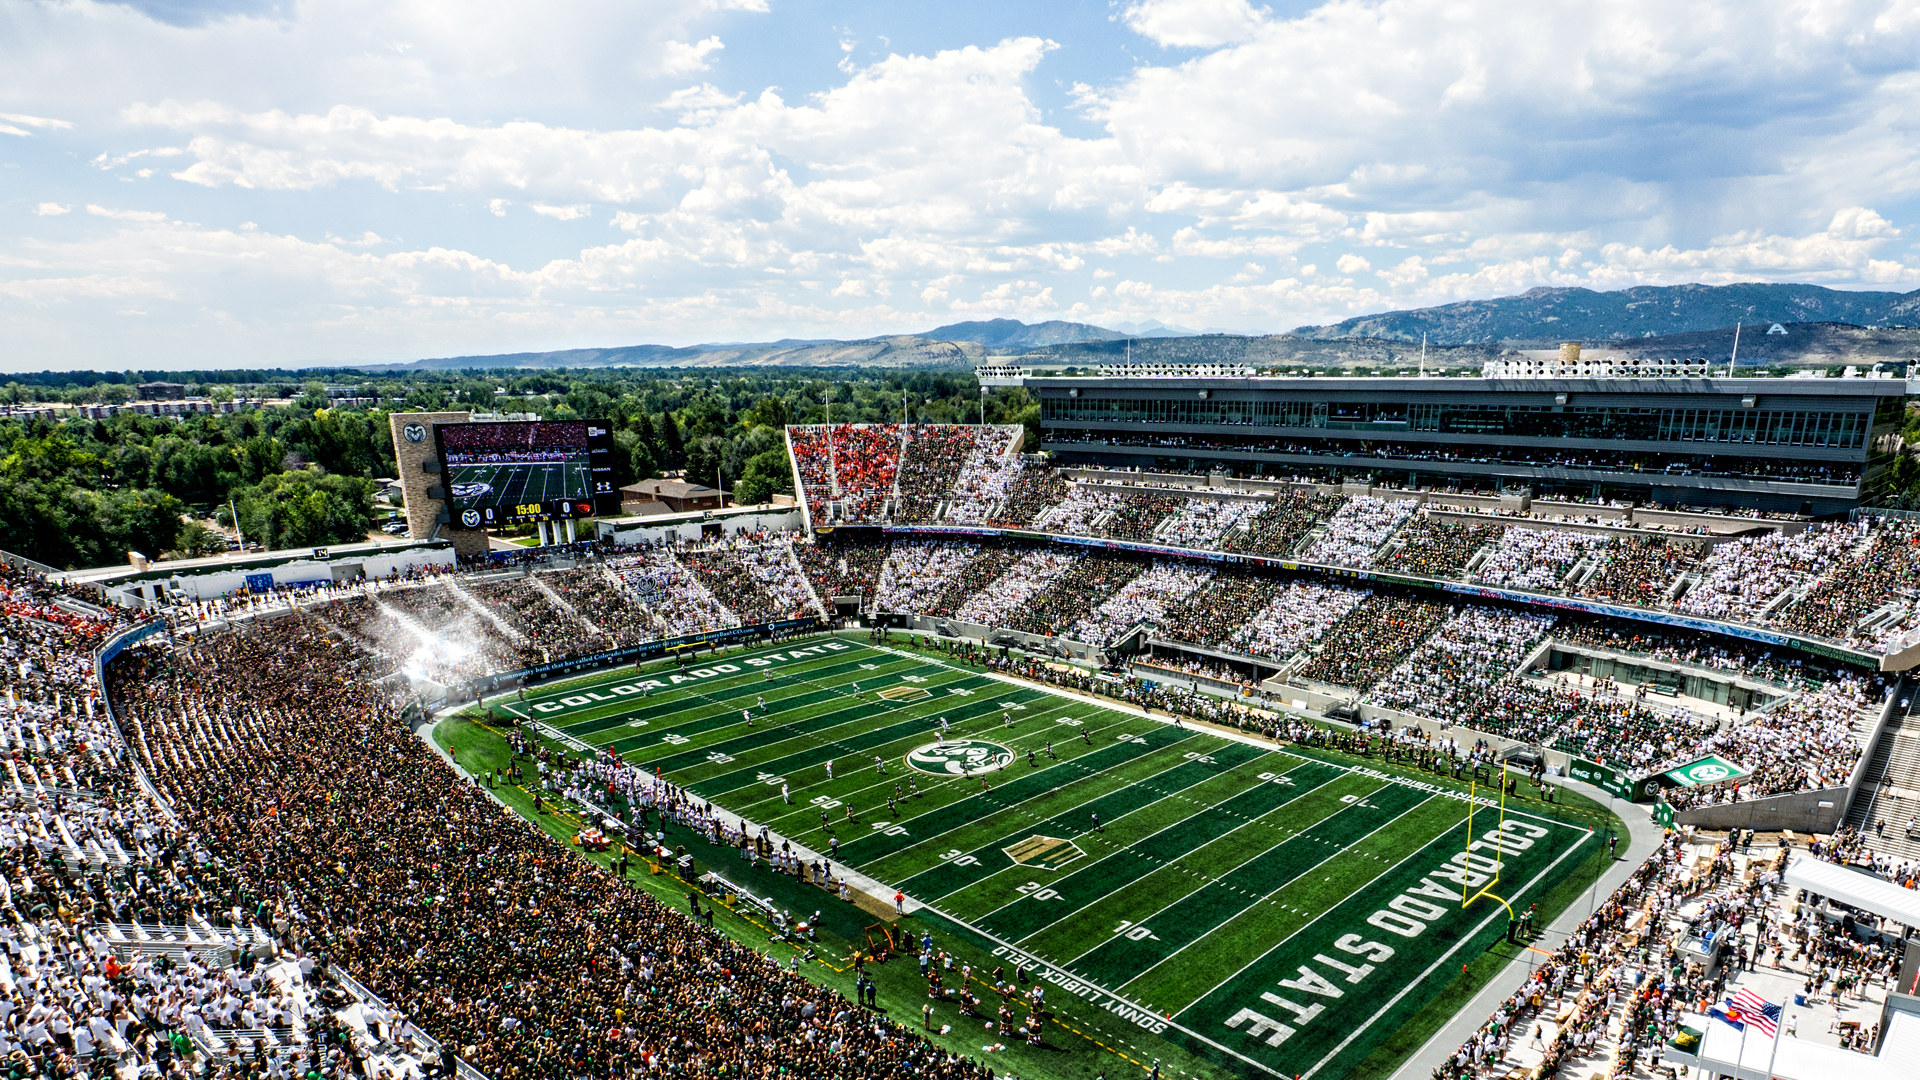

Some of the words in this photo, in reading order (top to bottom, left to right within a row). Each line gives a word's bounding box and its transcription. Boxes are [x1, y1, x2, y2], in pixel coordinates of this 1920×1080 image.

[1766, 323, 1788, 334] A
[485, 508, 493, 520] 0
[515, 503, 541, 515] 15:00
[562, 502, 570, 513] 0
[318, 549, 327, 557] 14
[1282, 562, 1297, 570] 15:00
[535, 664, 550, 673] bank
[551, 662, 564, 670] that
[564, 659, 575, 667] has
[576, 656, 593, 664] called
[594, 650, 622, 661] Colorado
[622, 647, 638, 655] home
[1800, 645, 1829, 657] COLORADO
[1845, 656, 1876, 668] UNIVERSITY
[1832, 648, 1856, 658] PARTNER
[532, 664, 742, 713] COLORADO
[744, 642, 850, 667] STATE
[756, 772, 786, 786] 40
[1257, 772, 1292, 784] 20
[1350, 765, 1390, 778] FIELD
[1395, 775, 1444, 793] LUBICK
[809, 795, 843, 809] 50
[1339, 794, 1370, 808] 10
[1445, 790, 1499, 806] SONNY
[871, 821, 907, 836] 40
[939, 849, 977, 867] 30
[1366, 819, 1549, 938] COLORADO
[1015, 881, 1059, 902] 20
[1113, 920, 1152, 941] 10
[991, 946, 1041, 972] FIELD
[1036, 968, 1102, 1002] LUBICK
[1224, 933, 1395, 1048] STATE
[1099, 1000, 1168, 1034] SONNY
